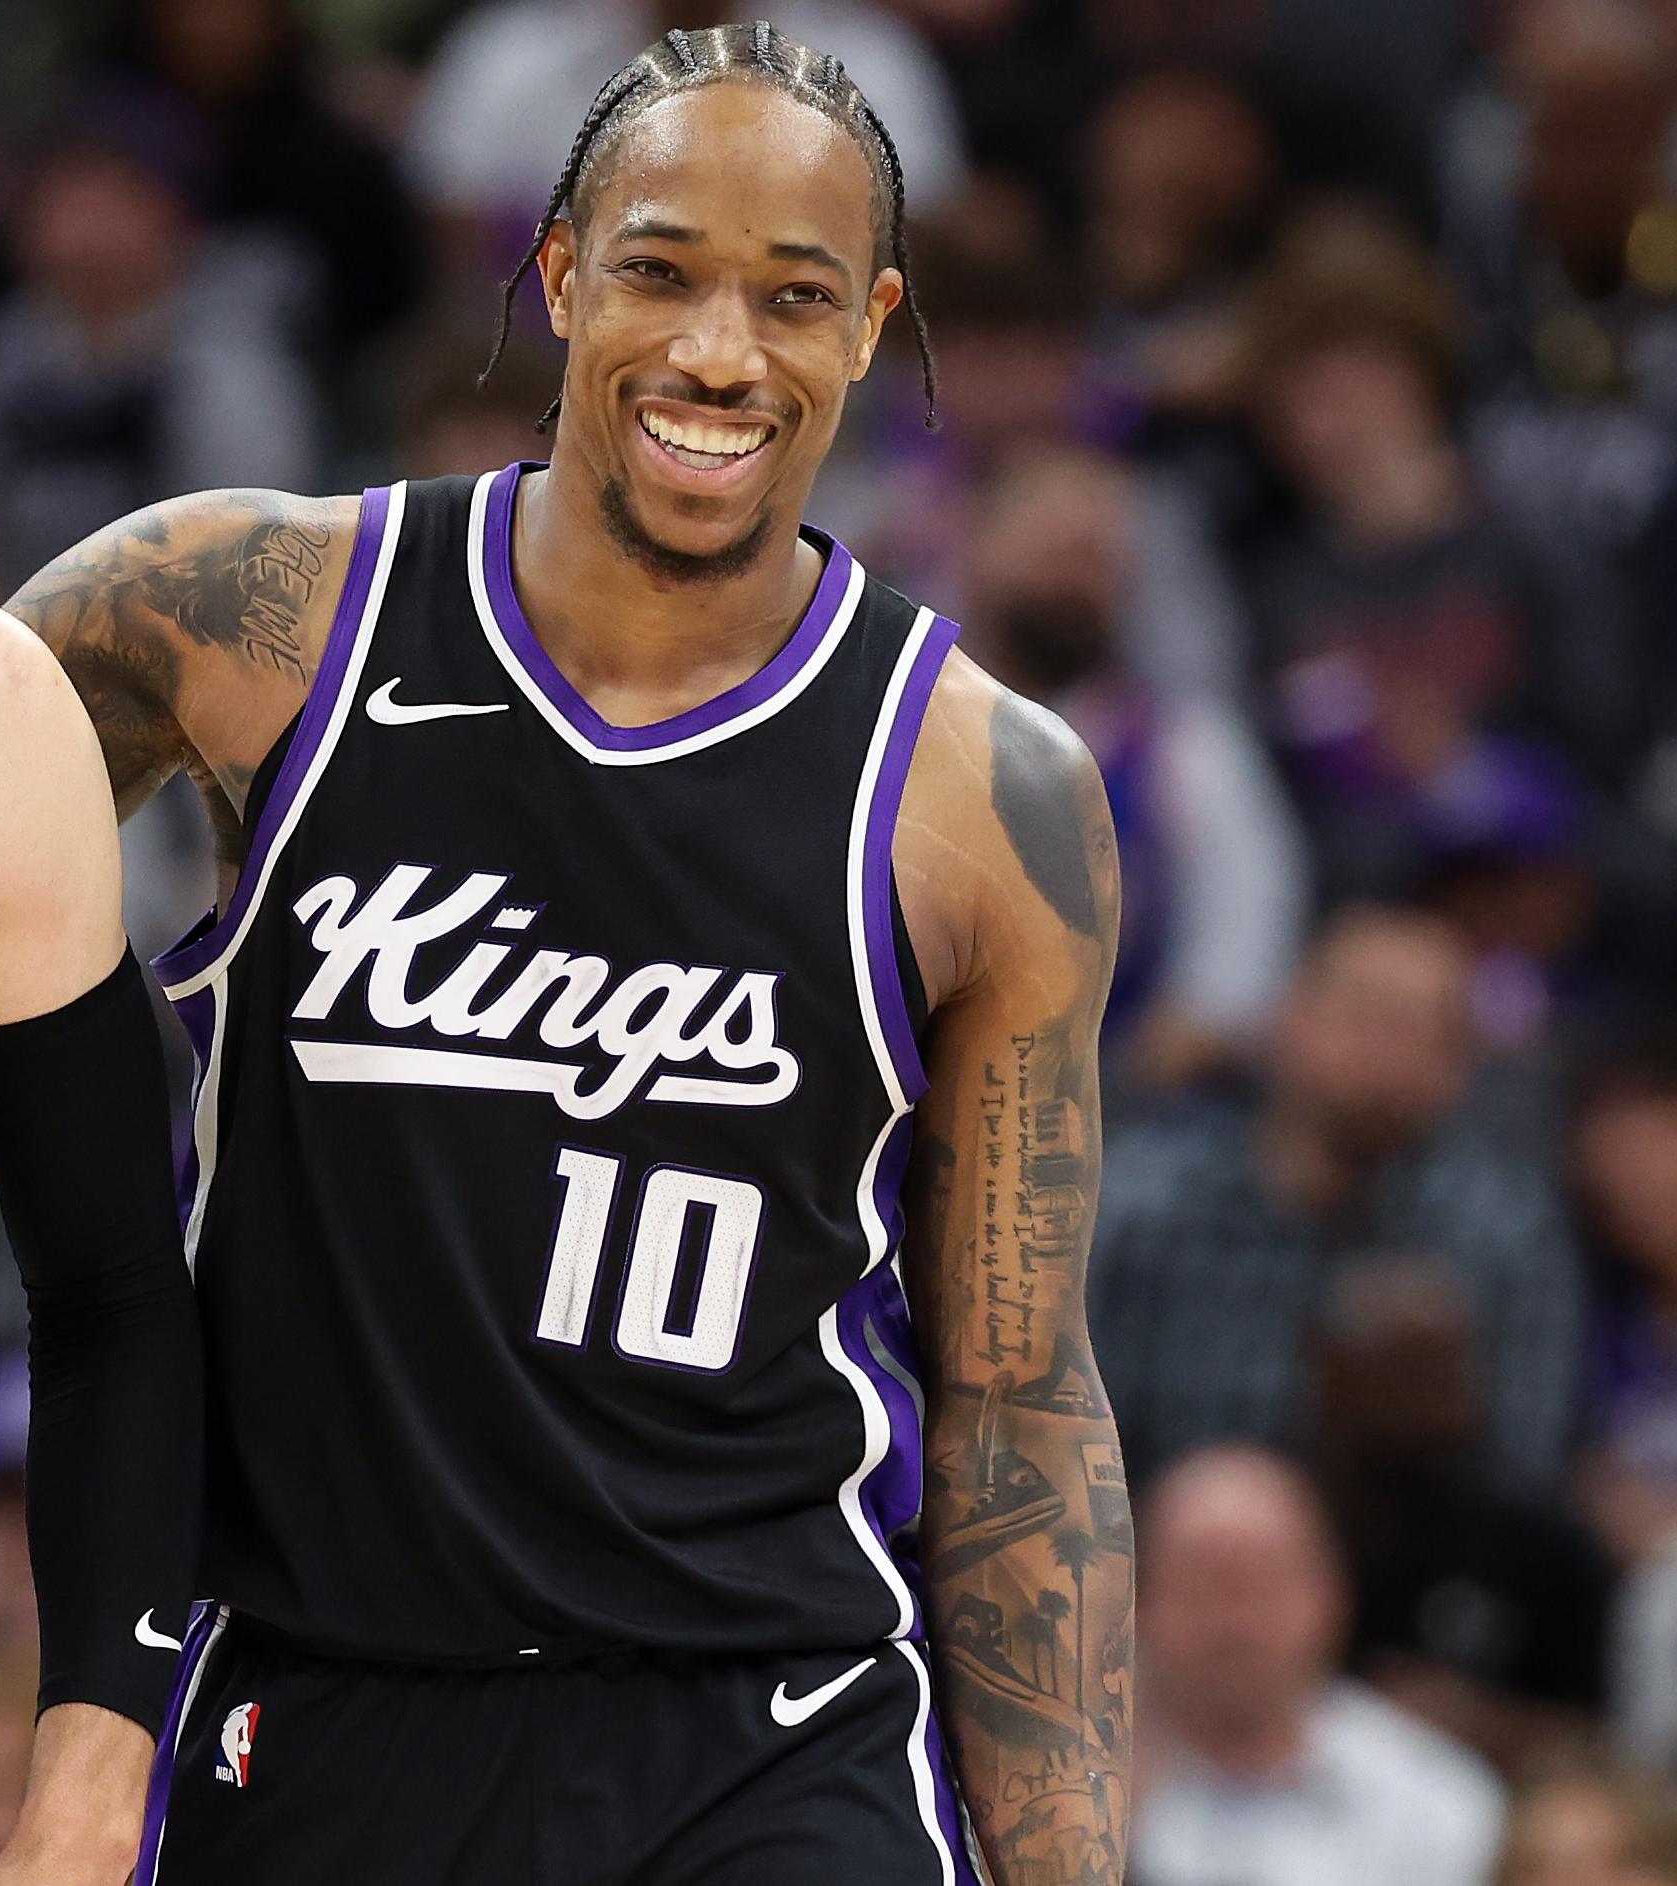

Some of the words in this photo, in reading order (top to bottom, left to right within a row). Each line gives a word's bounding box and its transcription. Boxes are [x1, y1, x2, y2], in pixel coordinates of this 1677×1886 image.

[284, 861, 804, 1120] Kings
[530, 1141, 769, 1377] 10
[215, 1765, 234, 1783] NBA
